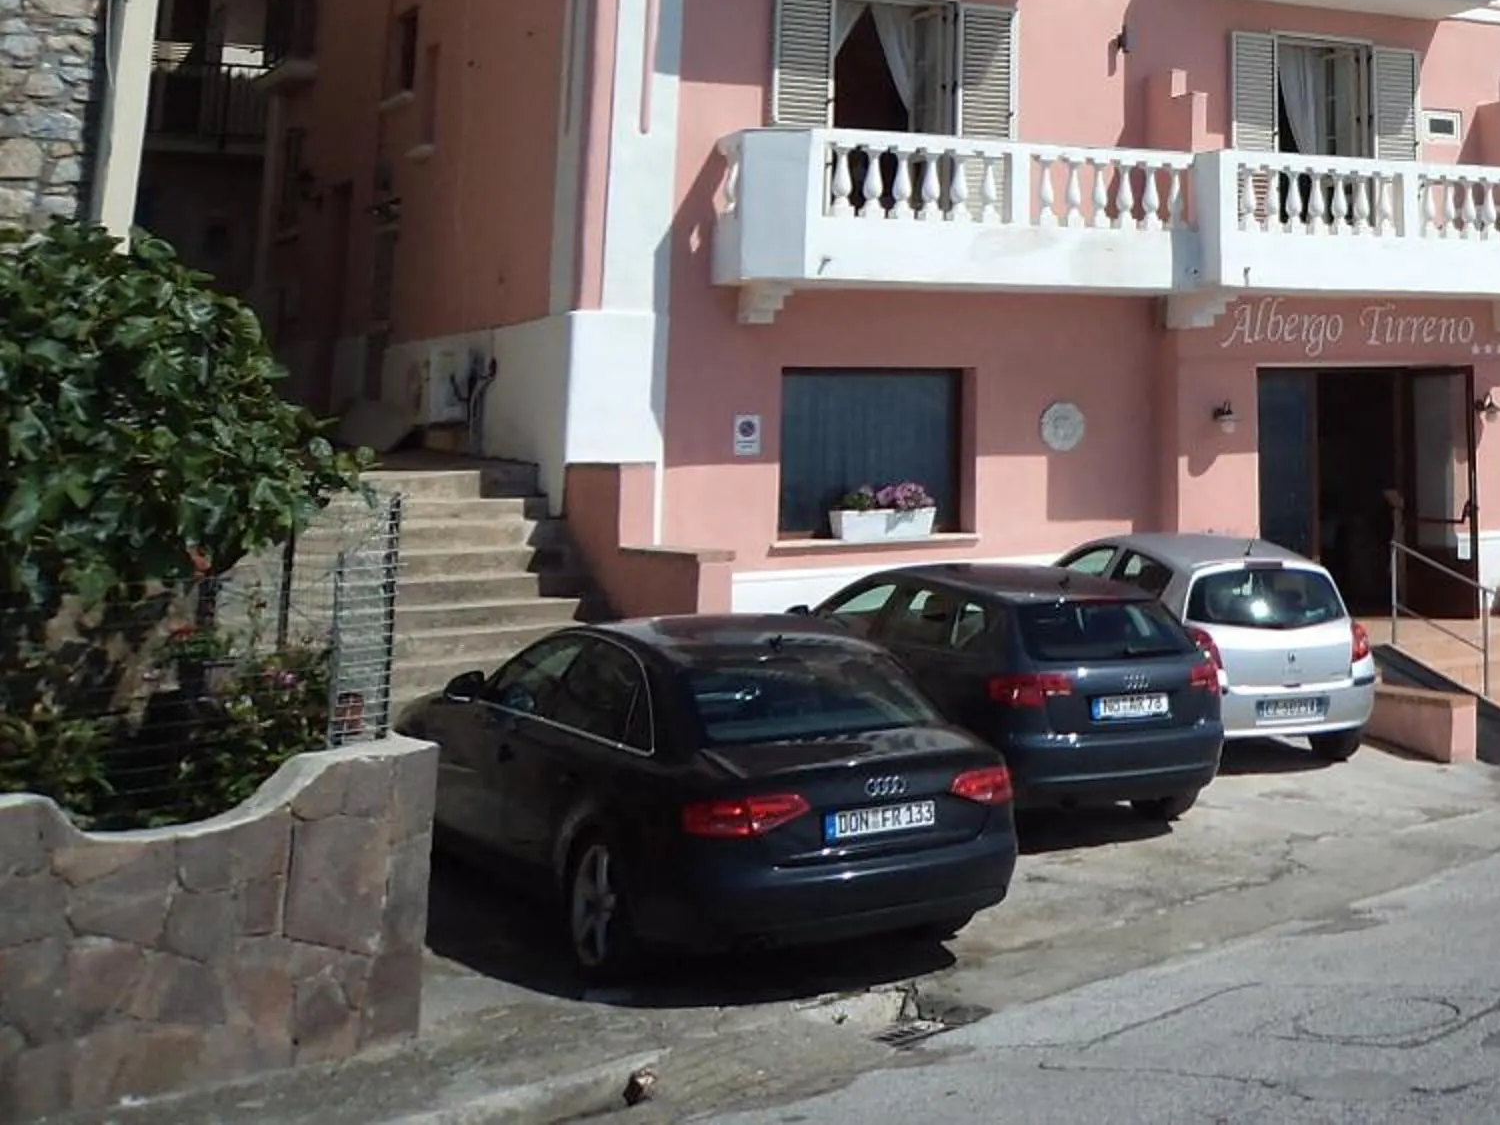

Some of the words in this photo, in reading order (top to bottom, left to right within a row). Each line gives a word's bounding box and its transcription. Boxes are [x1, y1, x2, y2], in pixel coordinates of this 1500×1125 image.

[1220, 296, 1344, 357] Albergo
[1359, 303, 1475, 346] Tirreno
[838, 810, 870, 834] DON
